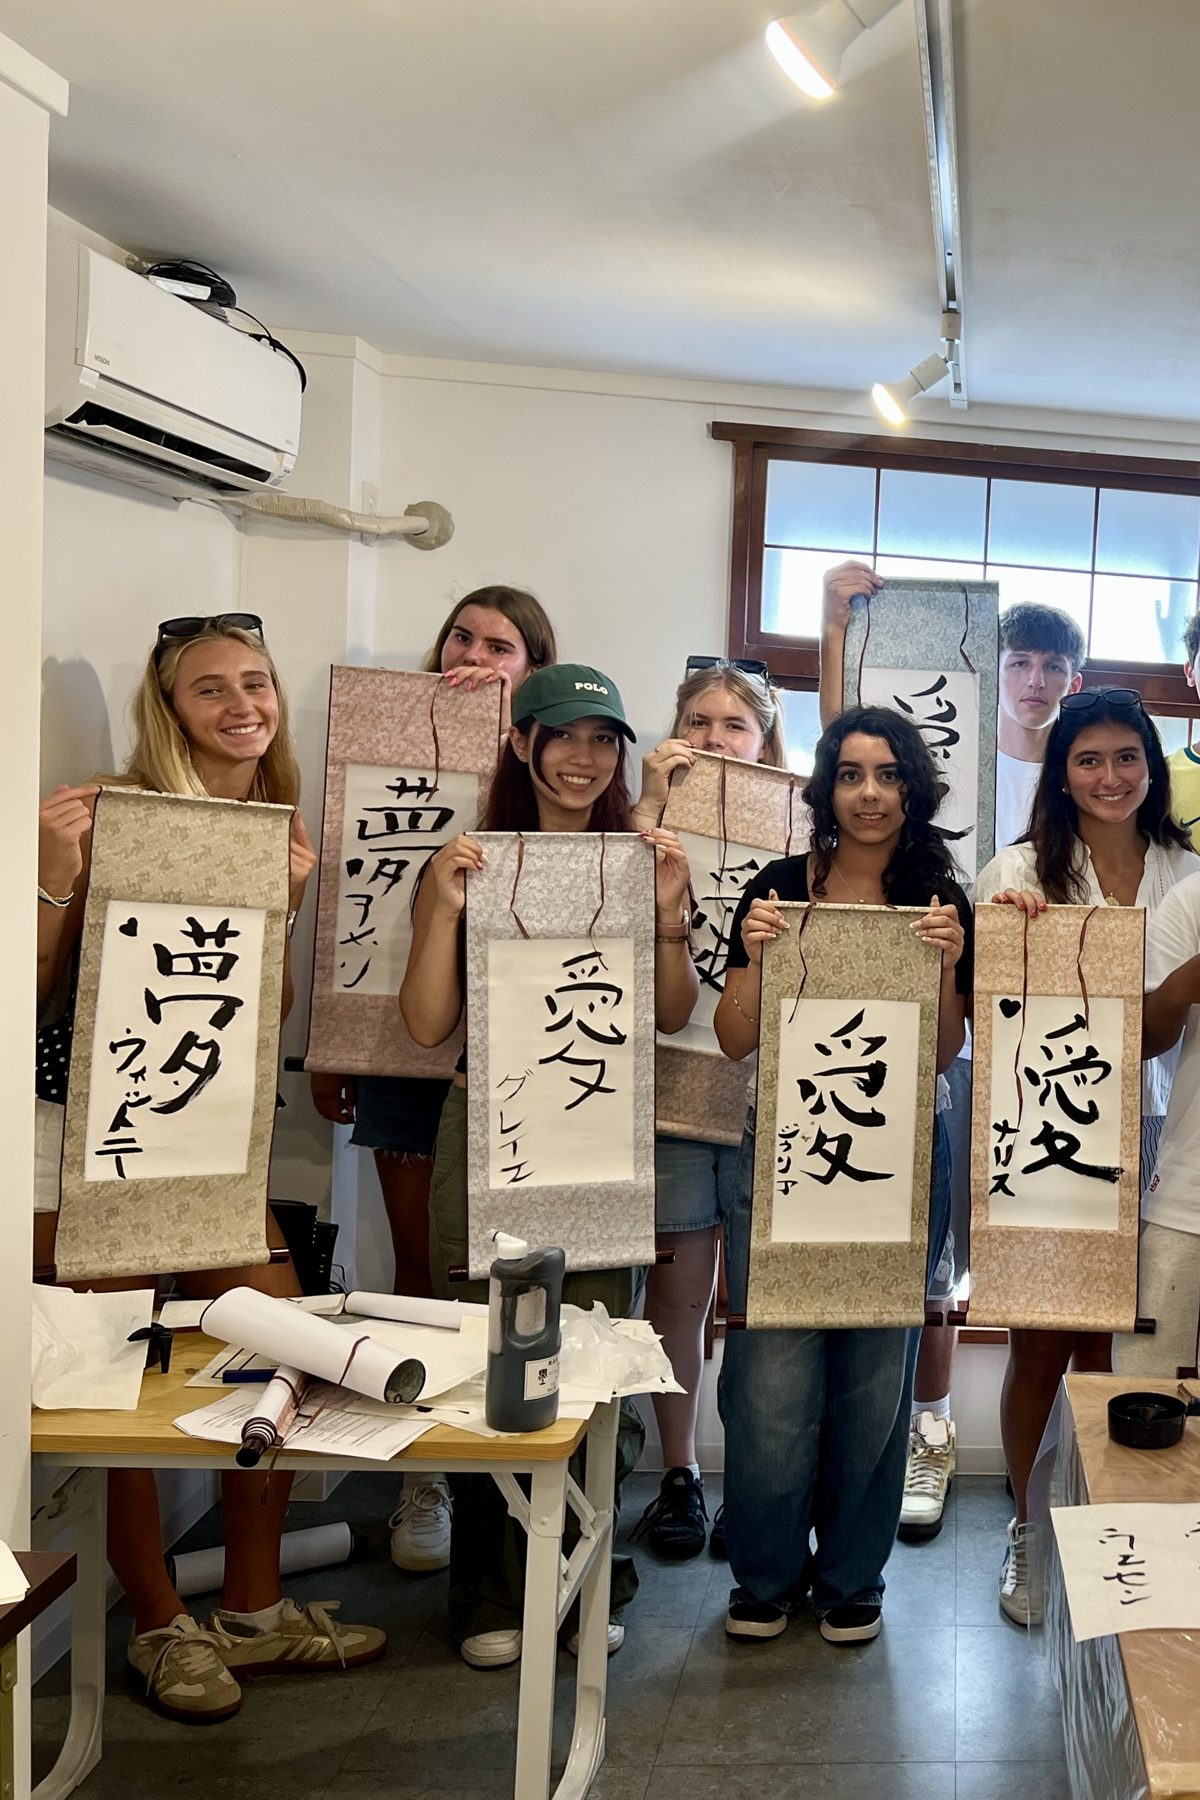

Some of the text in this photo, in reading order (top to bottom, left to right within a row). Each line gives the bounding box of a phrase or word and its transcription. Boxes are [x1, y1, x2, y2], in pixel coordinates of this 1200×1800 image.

[574, 682, 609, 695] POLO
[144, 916, 245, 1115] 夢
[538, 951, 628, 1112] 愛
[796, 1007, 896, 1186] 愛
[1020, 1012, 1126, 1184] 愛
